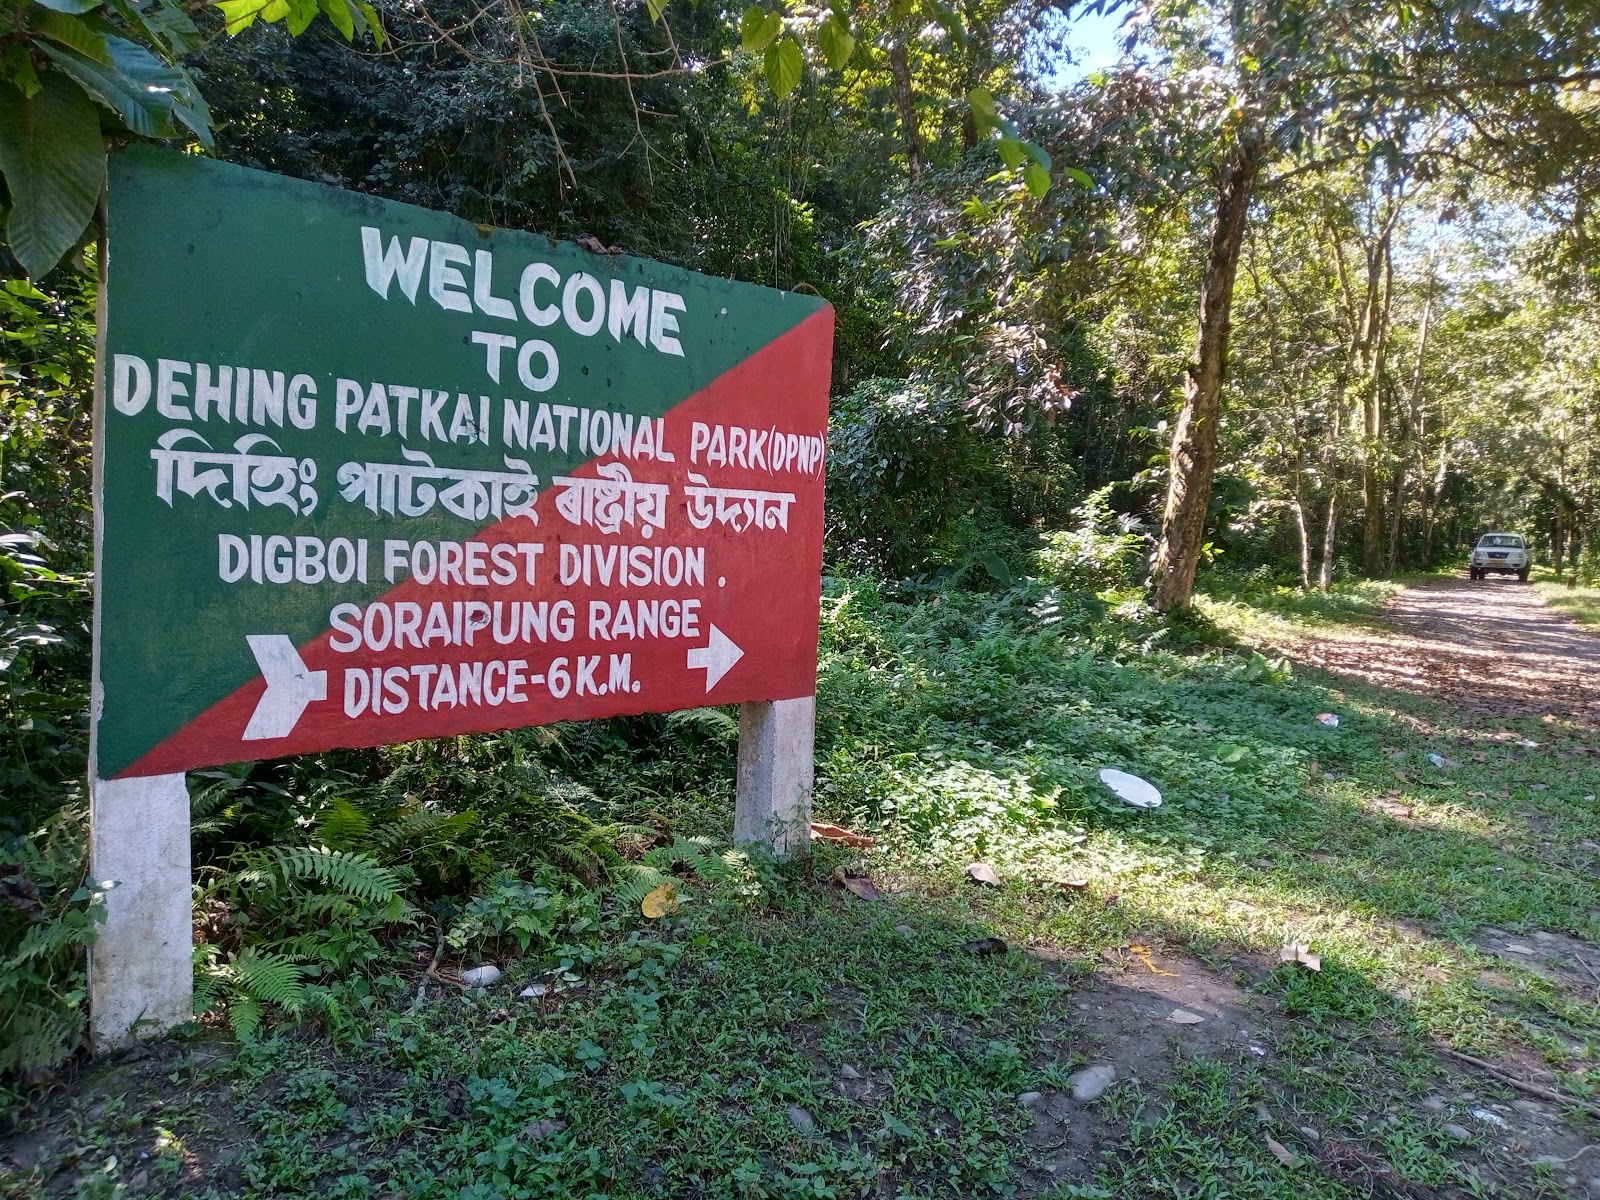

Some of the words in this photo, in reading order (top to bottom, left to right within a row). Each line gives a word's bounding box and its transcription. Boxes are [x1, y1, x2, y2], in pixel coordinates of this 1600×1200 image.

[361, 226, 687, 358] WELCOME
[472, 331, 560, 392] TO
[113, 353, 318, 430] DEHING
[335, 378, 490, 446] PATKAI
[503, 398, 676, 463] NATIONAL
[150, 427, 319, 517] দিহিং
[336, 444, 540, 527] পাটকাই
[683, 469, 797, 534] উদ্যান
[218, 533, 368, 585] DIGBOI
[383, 539, 545, 587] FOREST
[329, 600, 576, 653] SORAIPUNG
[588, 598, 703, 642] RANGE
